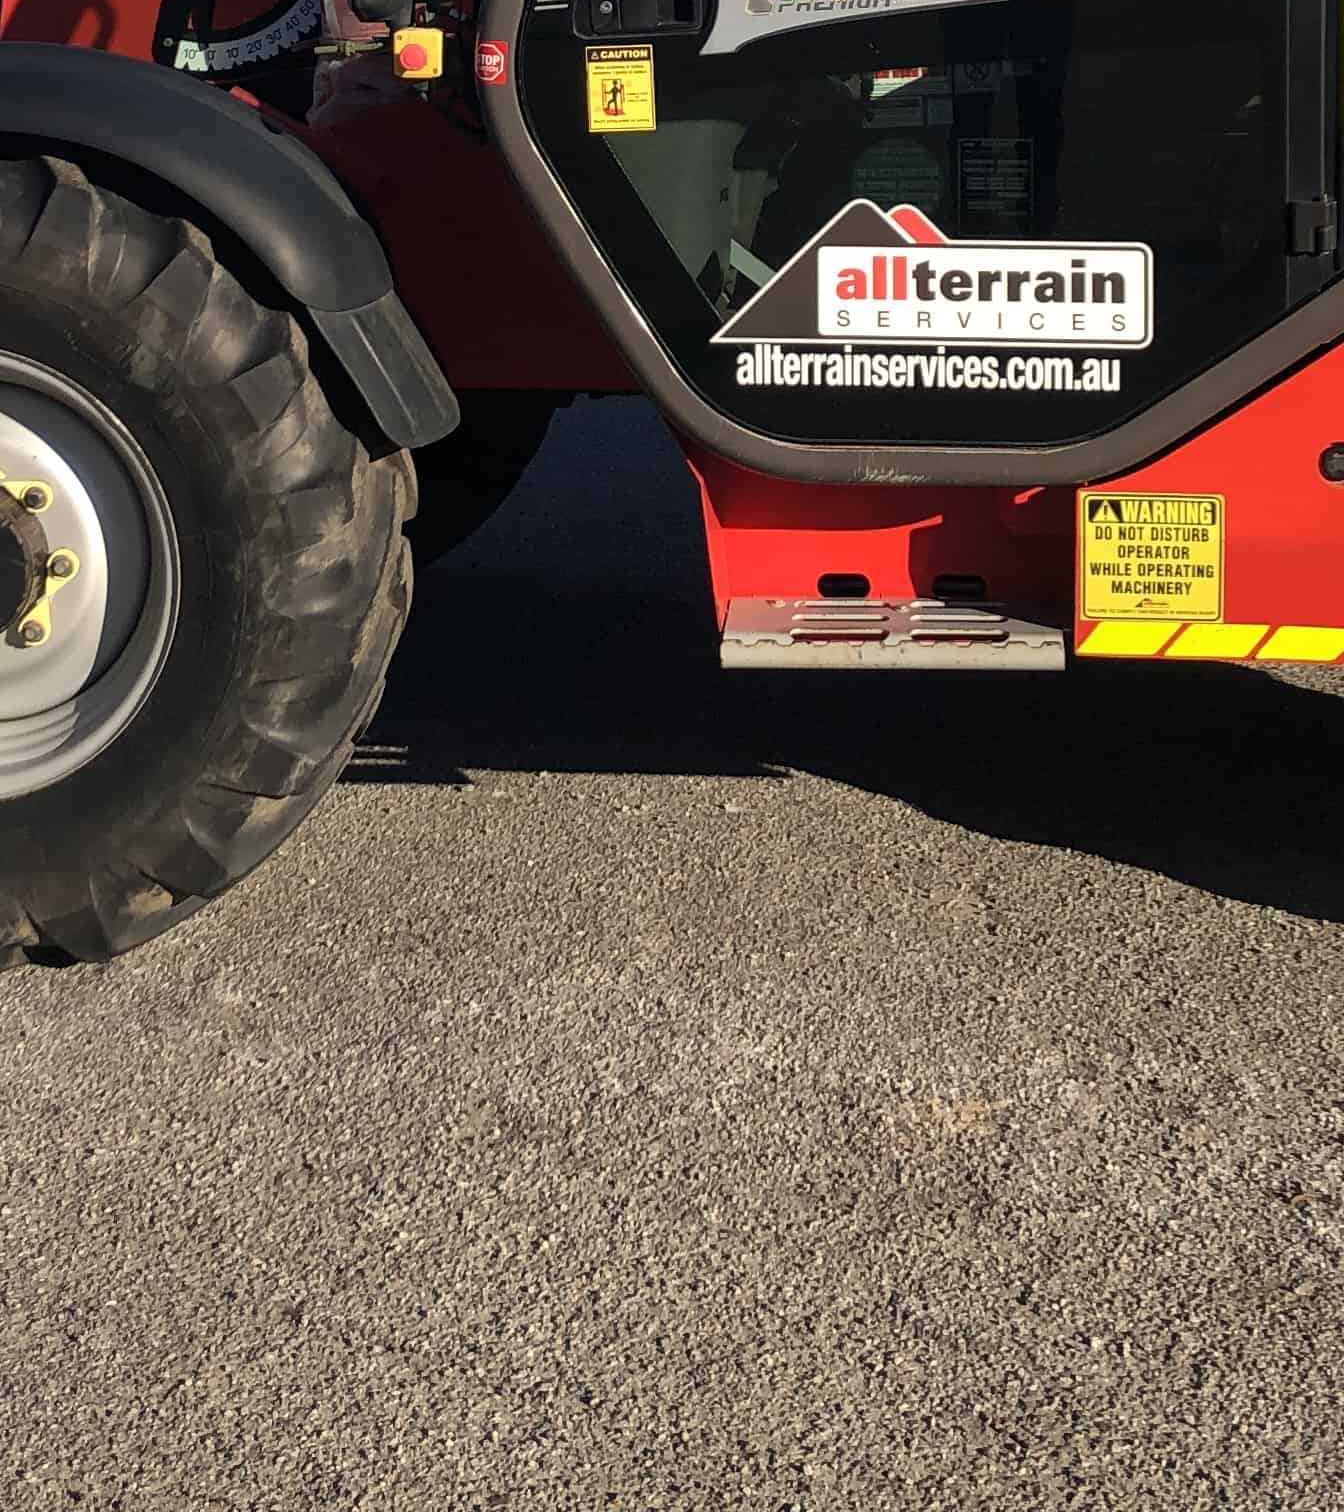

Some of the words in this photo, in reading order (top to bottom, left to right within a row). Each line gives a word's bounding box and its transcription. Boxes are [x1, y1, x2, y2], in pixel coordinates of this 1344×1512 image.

[600, 49, 648, 59] CAUTION
[836, 255, 1126, 304] allterrain
[836, 311, 1126, 331] SERVICES
[736, 344, 1121, 391] allterrainservices.com.au
[1120, 500, 1213, 524] WARNING
[1095, 526, 1112, 540] DO
[1119, 526, 1145, 541] NOT
[1151, 527, 1209, 542] DISTURB
[1117, 545, 1190, 560] OPERATOR
[1090, 563, 1132, 577] WHILE
[1137, 563, 1214, 578] OPERATING
[1111, 580, 1192, 595] MACHINERY
